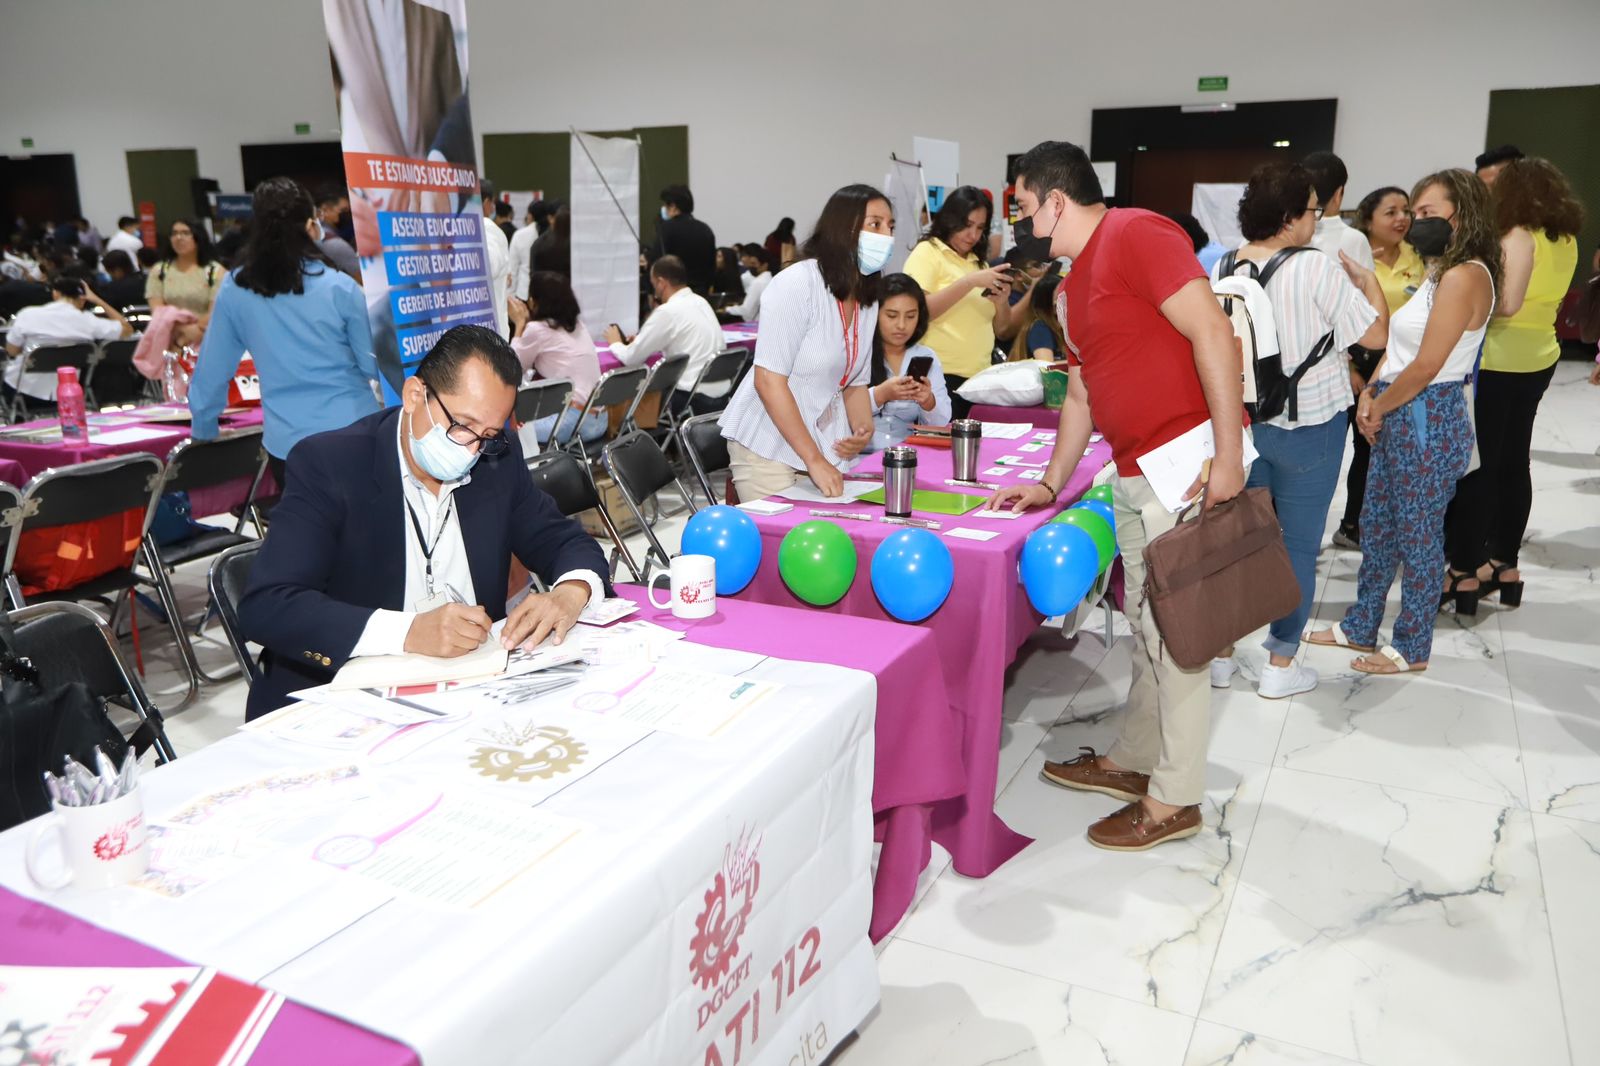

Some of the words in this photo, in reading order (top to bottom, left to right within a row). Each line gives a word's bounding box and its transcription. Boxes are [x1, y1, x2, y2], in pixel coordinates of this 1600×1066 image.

[367, 159, 383, 181] TE
[385, 161, 427, 185] ESTAMOS
[427, 165, 476, 188] BUSCANDO
[392, 217, 425, 238] ASESOR
[427, 217, 476, 237] EDUCATIVO
[396, 254, 430, 277] GESTOR
[431, 251, 480, 274] EDUCATIVO
[398, 293, 433, 315] GERENTE
[433, 292, 446, 309] DE
[446, 287, 490, 307] ADMISIONES
[771, 926, 822, 1014] 112
[697, 952, 753, 1032] DGCFT
